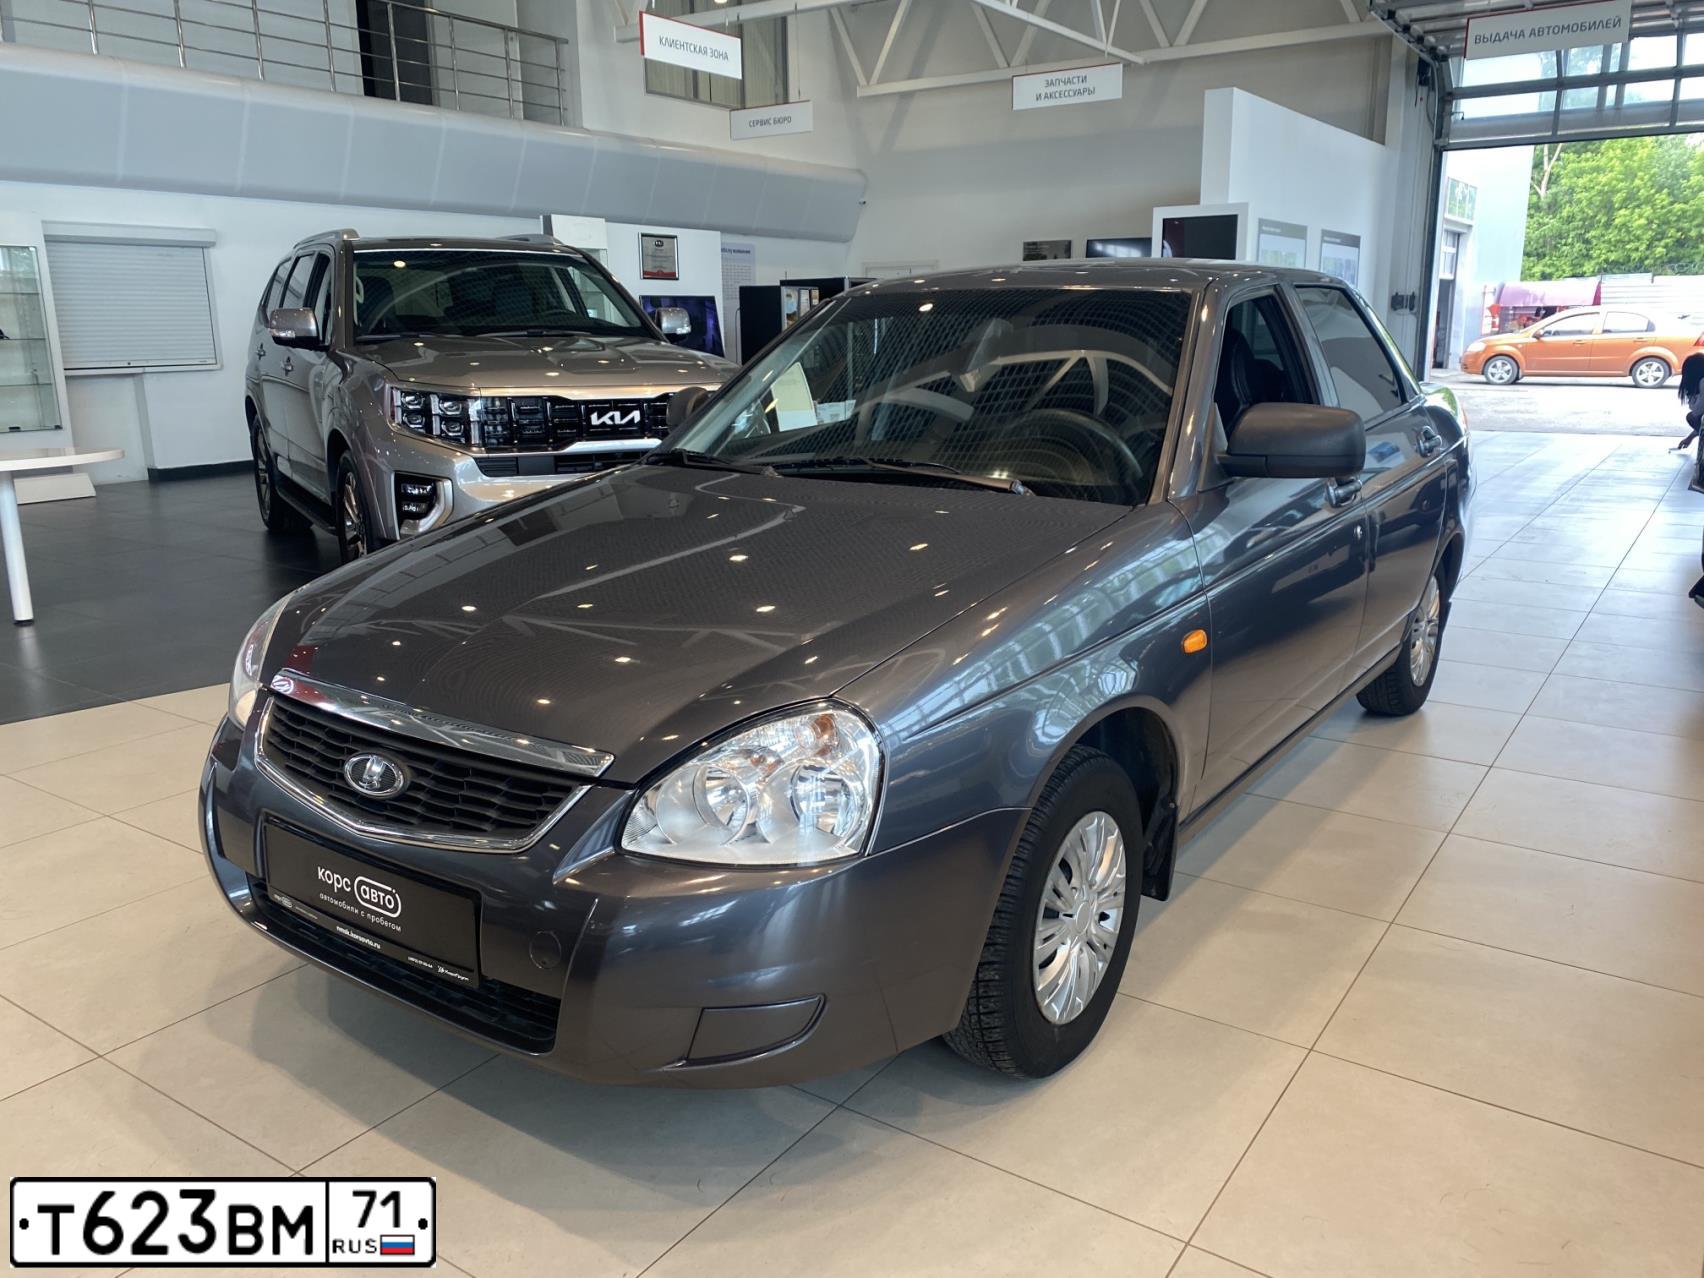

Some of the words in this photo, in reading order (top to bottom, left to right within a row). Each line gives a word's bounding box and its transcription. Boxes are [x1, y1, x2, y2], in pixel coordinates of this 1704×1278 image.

[1474, 28, 1526, 45] ВЫДАЧА
[1528, 15, 1622, 38] АВТОМОБИЛЕЙ
[658, 35, 708, 56] КЛИЕНТСКАЯ
[709, 47, 729, 61] ЗОНА
[1044, 74, 1088, 88] ЗАПЧАСТИ
[1035, 93, 1042, 102] И
[1043, 86, 1096, 101] АКСЕССУАРЫ
[748, 117, 772, 128] СЕРВИС
[772, 115, 792, 126] БЮРО
[590, 409, 641, 426] KIA
[317, 866, 352, 893] корс
[360, 885, 395, 909] авто
[319, 893, 359, 914] автомобили
[366, 913, 402, 932] пробегом
